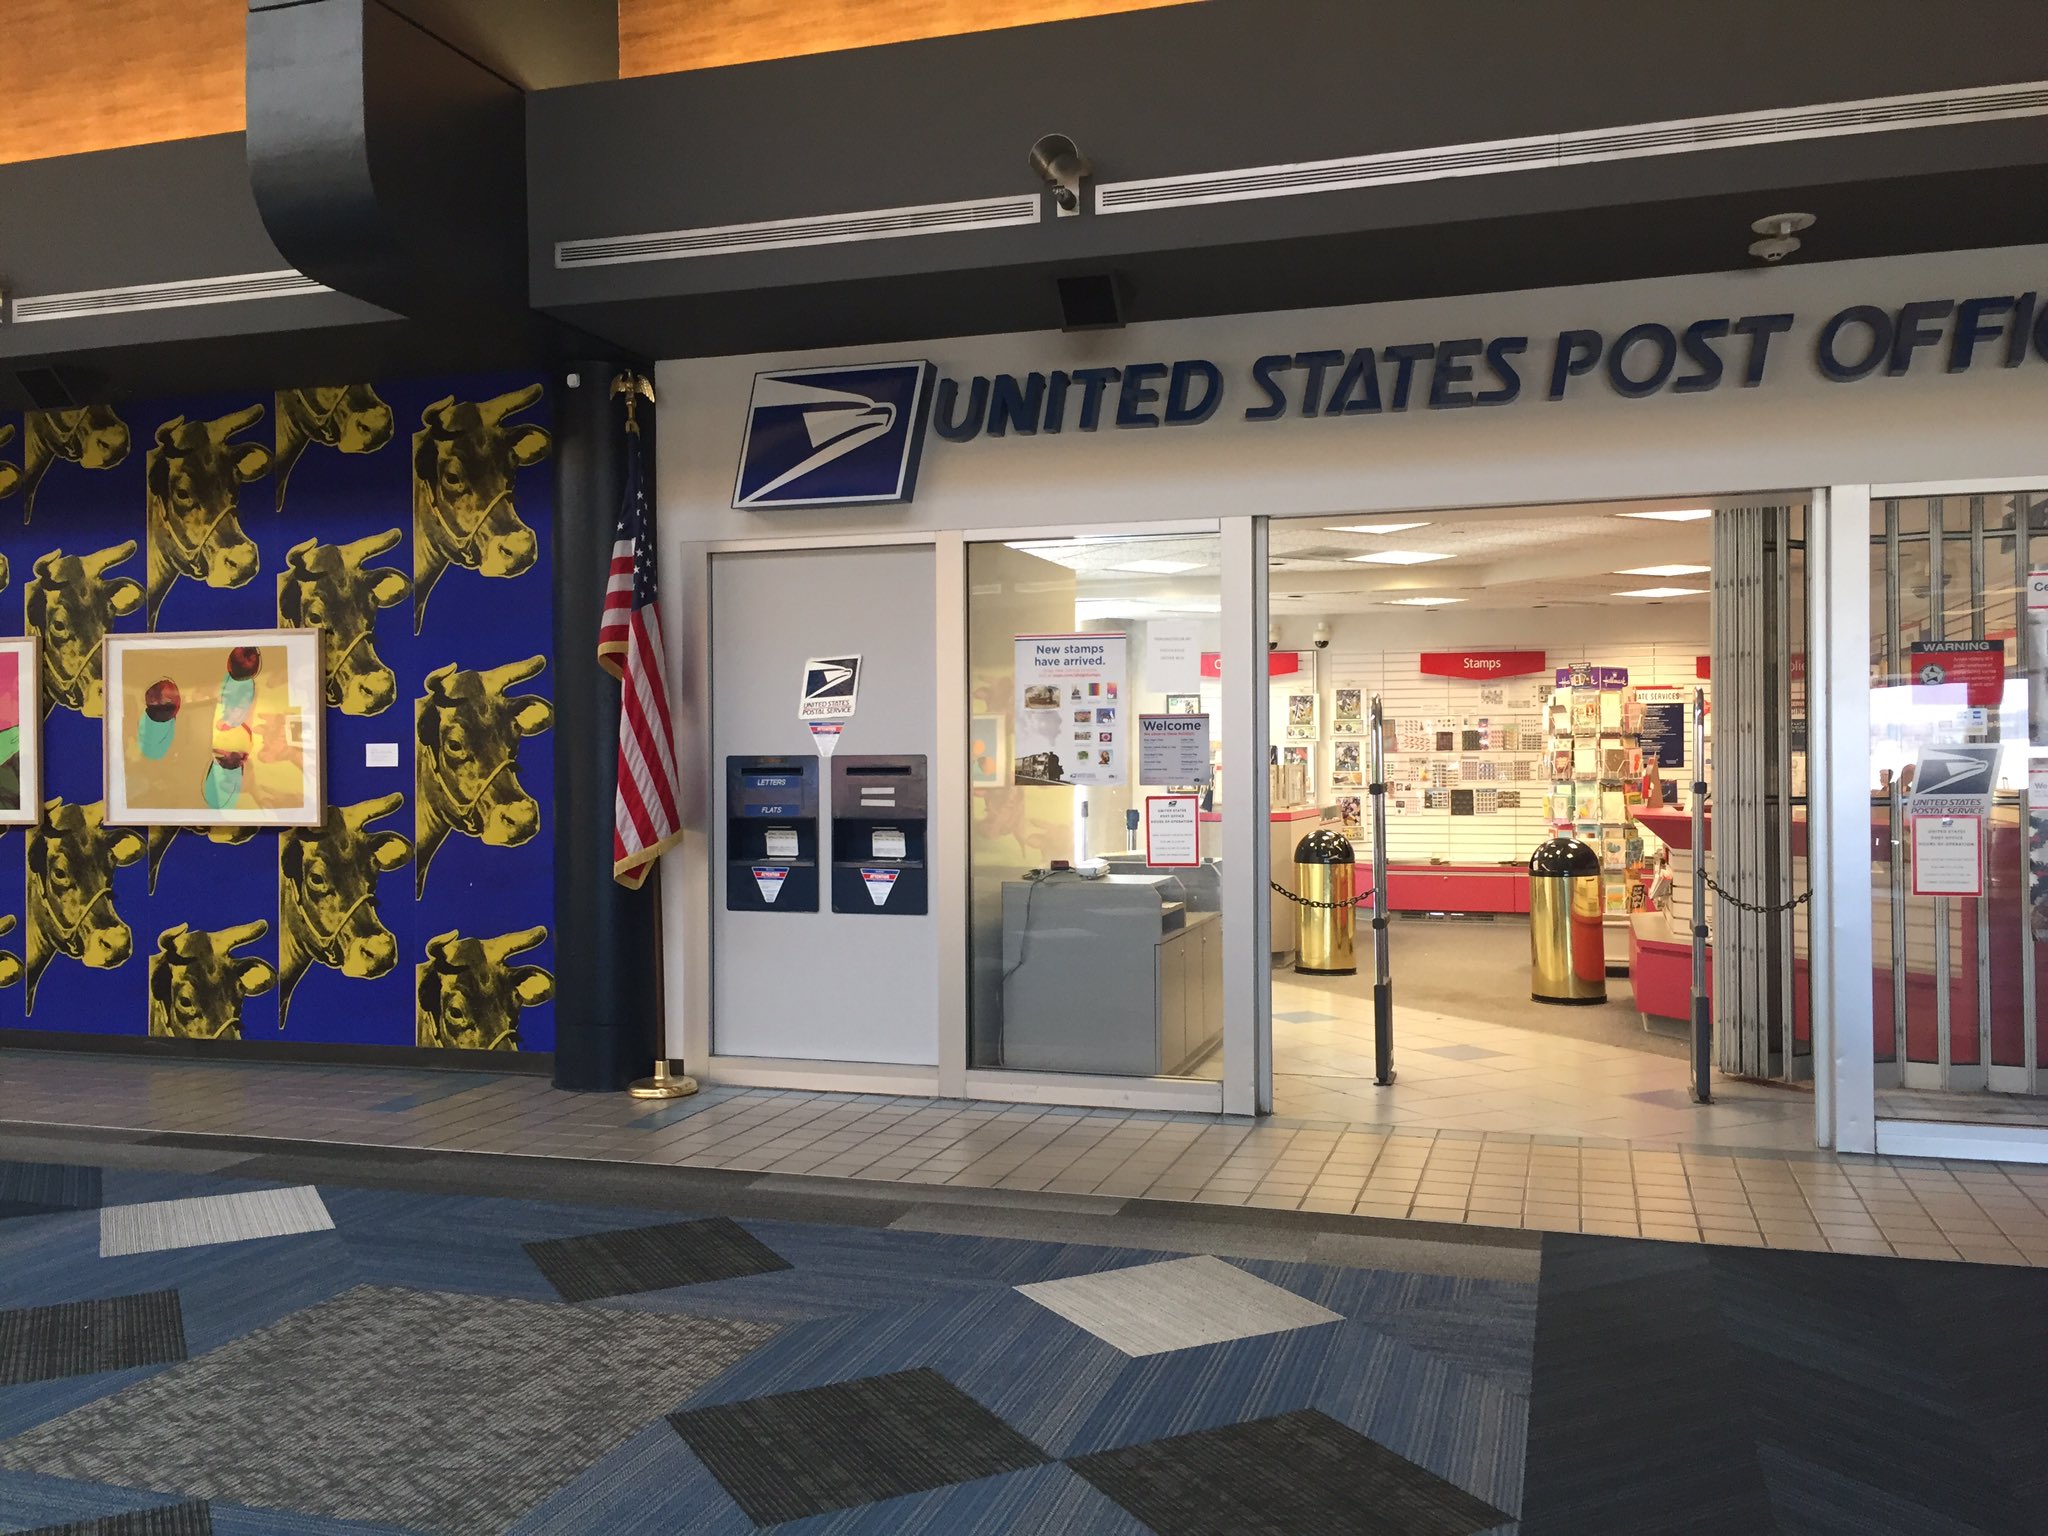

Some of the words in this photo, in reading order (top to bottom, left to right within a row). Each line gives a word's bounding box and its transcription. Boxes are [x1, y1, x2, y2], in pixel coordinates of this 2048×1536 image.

[934, 360, 1222, 443] UNITED
[1245, 337, 1527, 421] STATES
[1550, 313, 1795, 402] POST
[1819, 291, 2048, 384] OFFI
[1036, 645, 1061, 654] New
[1064, 644, 1104, 655] stamps
[1923, 642, 1990, 651] WARNING
[1034, 656, 1060, 666] have
[1063, 656, 1106, 666] arrived.
[1463, 657, 1502, 671] Stamps
[803, 701, 828, 709] UNITED
[827, 706, 851, 714] SERVICE
[1143, 720, 1201, 731] Welcome
[757, 778, 787, 786] LETTERS
[1912, 798, 1948, 806] UNITED
[1949, 798, 1982, 806] STATES
[761, 806, 782, 814] FLATS
[1947, 806, 1984, 814] SERVICE
